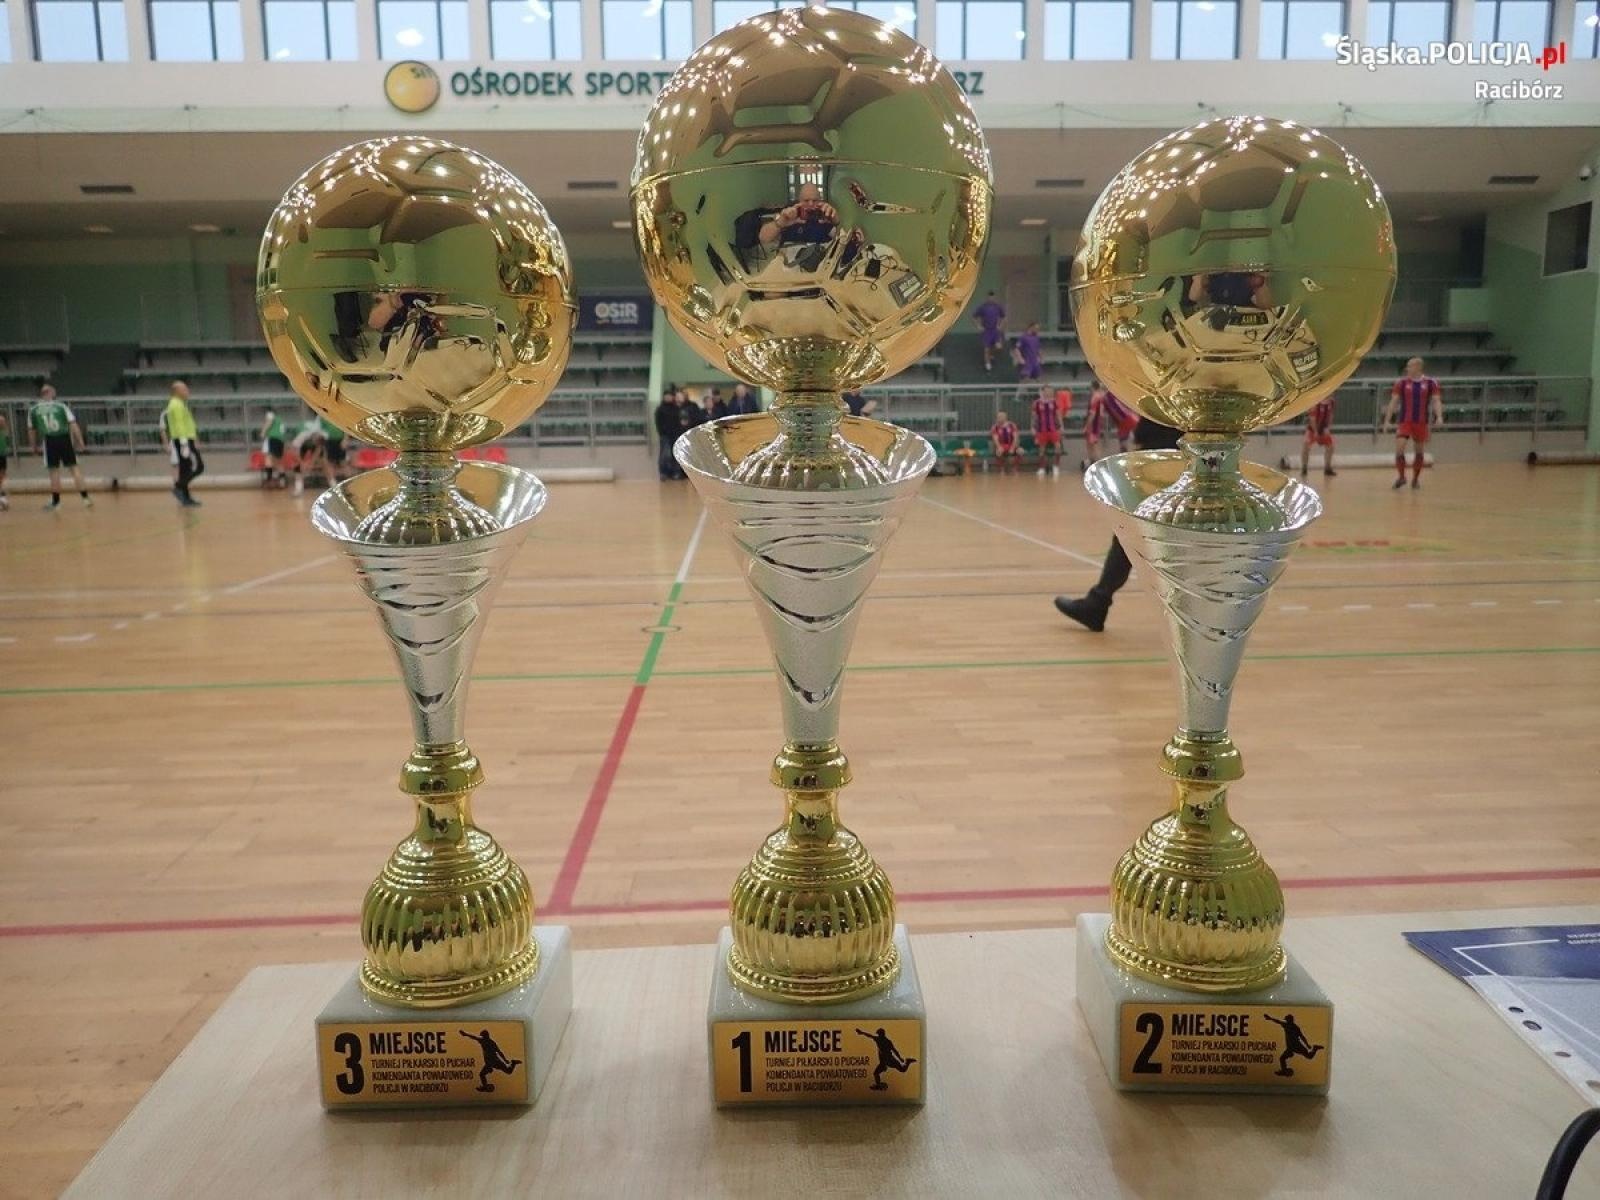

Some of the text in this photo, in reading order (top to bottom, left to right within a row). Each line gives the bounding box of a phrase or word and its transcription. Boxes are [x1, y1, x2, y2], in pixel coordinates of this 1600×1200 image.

[451, 66, 573, 96] OŚRODEK
[1132, 1012, 1249, 1074] 2 MIEJSCE
[334, 1032, 447, 1095] 3 MIEJSCE
[371, 1059, 401, 1068] TURNIEJ
[402, 1059, 439, 1068] PIŁKARSKI
[446, 1058, 475, 1067] PUCHAR
[731, 1030, 842, 1092] 1 MIEJSCE
[766, 1057, 795, 1067] TURNIEJ
[796, 1057, 833, 1067] PIŁKARSKI
[841, 1056, 870, 1066] PUCHAR
[371, 1071, 421, 1080] KOMENDANTA
[766, 1070, 815, 1079] KOMENDANTA
